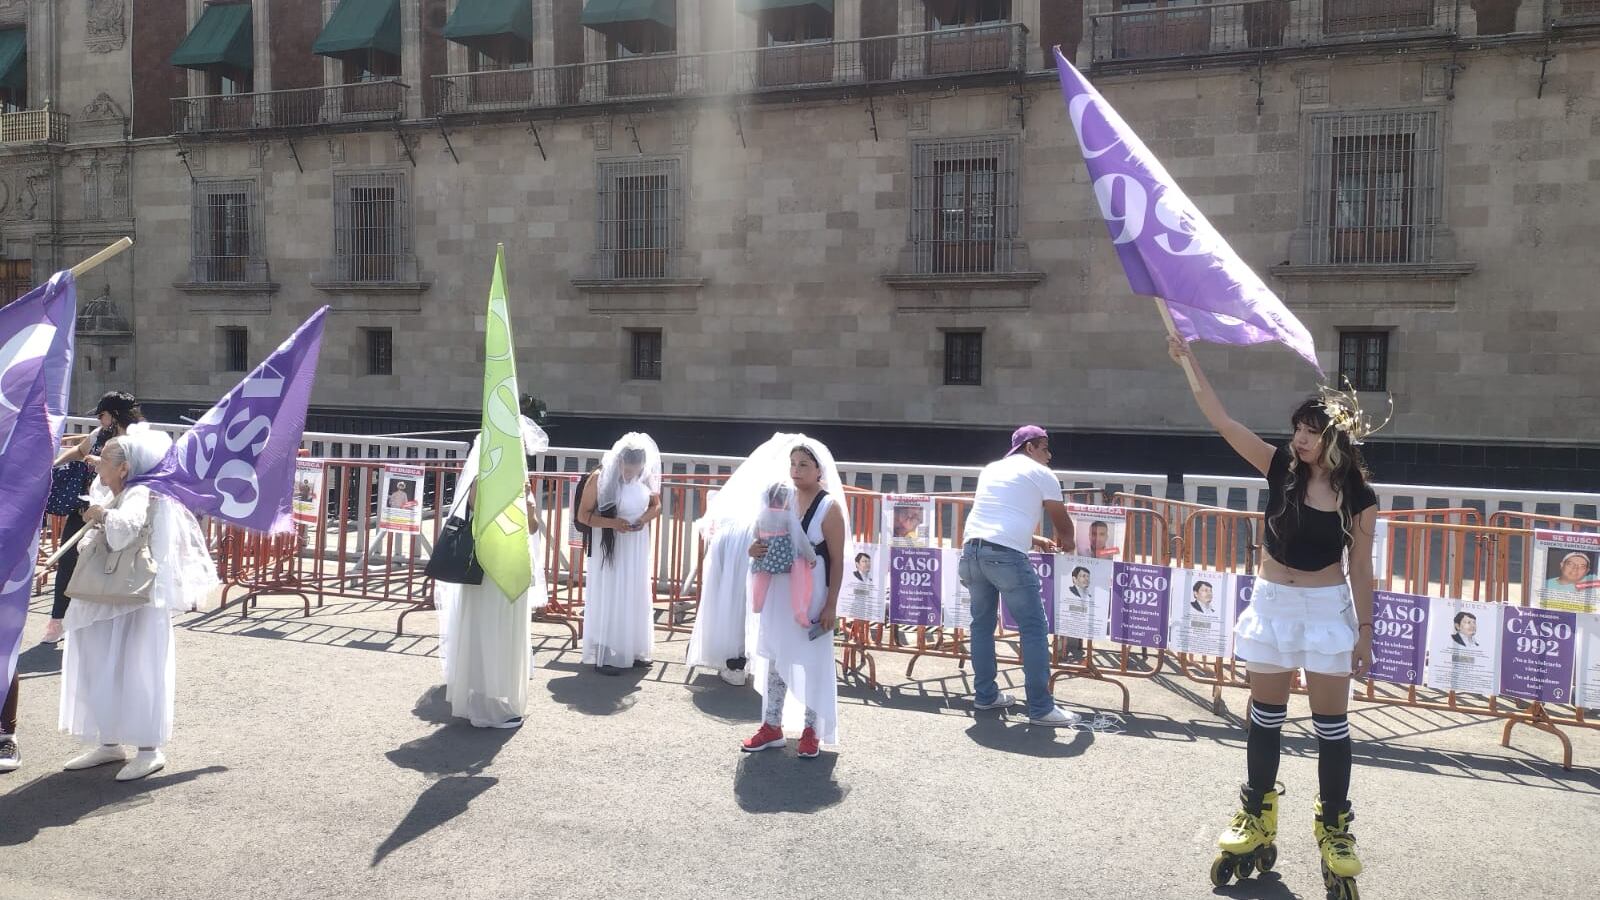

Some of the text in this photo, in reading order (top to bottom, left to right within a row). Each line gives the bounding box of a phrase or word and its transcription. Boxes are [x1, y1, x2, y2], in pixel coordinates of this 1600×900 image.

[1552, 534, 1565, 542] SE
[1567, 536, 1598, 545] BUSCA
[893, 556, 939, 571] CASO
[900, 572, 931, 587] 992
[1116, 572, 1168, 592] CASO
[1123, 589, 1158, 607] 992
[1374, 619, 1414, 640] 992
[1507, 617, 1572, 640] CASO
[1516, 636, 1559, 657] 992
